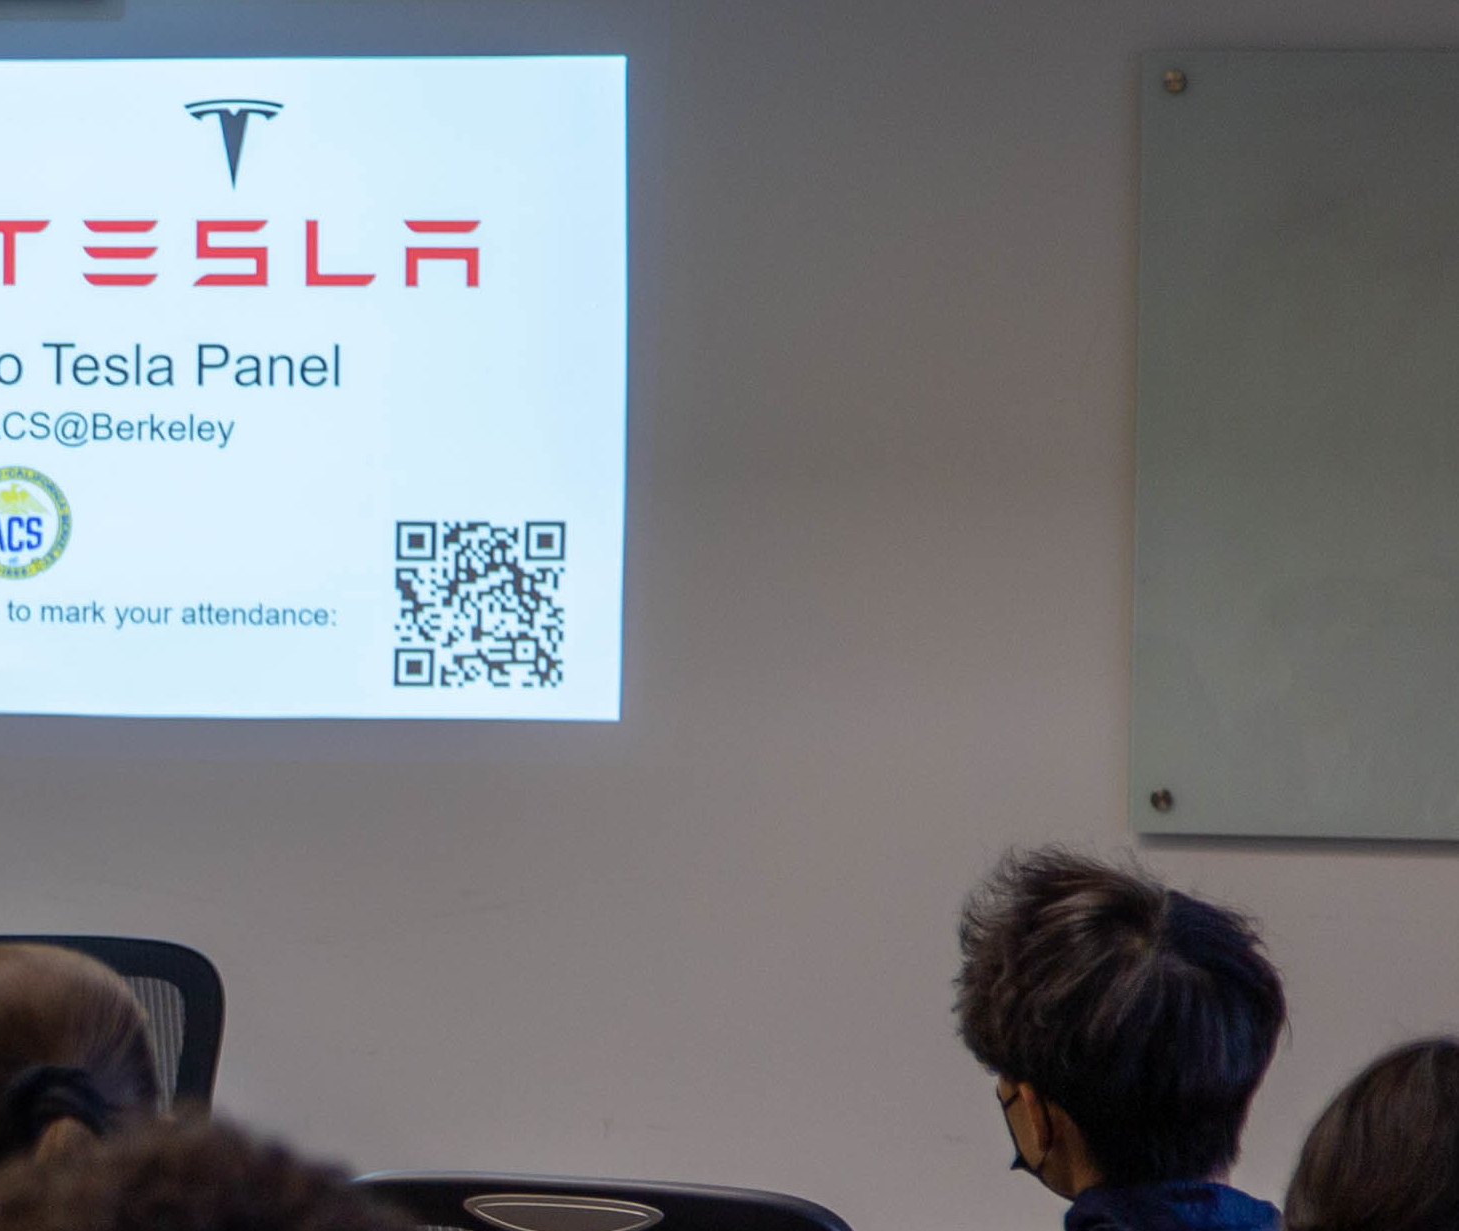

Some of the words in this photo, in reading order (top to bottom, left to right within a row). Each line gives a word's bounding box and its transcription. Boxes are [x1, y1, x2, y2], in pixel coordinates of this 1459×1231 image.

[41, 341, 175, 388] Tesla
[196, 342, 341, 388] Panel
[6, 599, 31, 623] to
[40, 600, 106, 624] mark
[114, 606, 173, 631] your
[181, 602, 337, 627] attendance:
